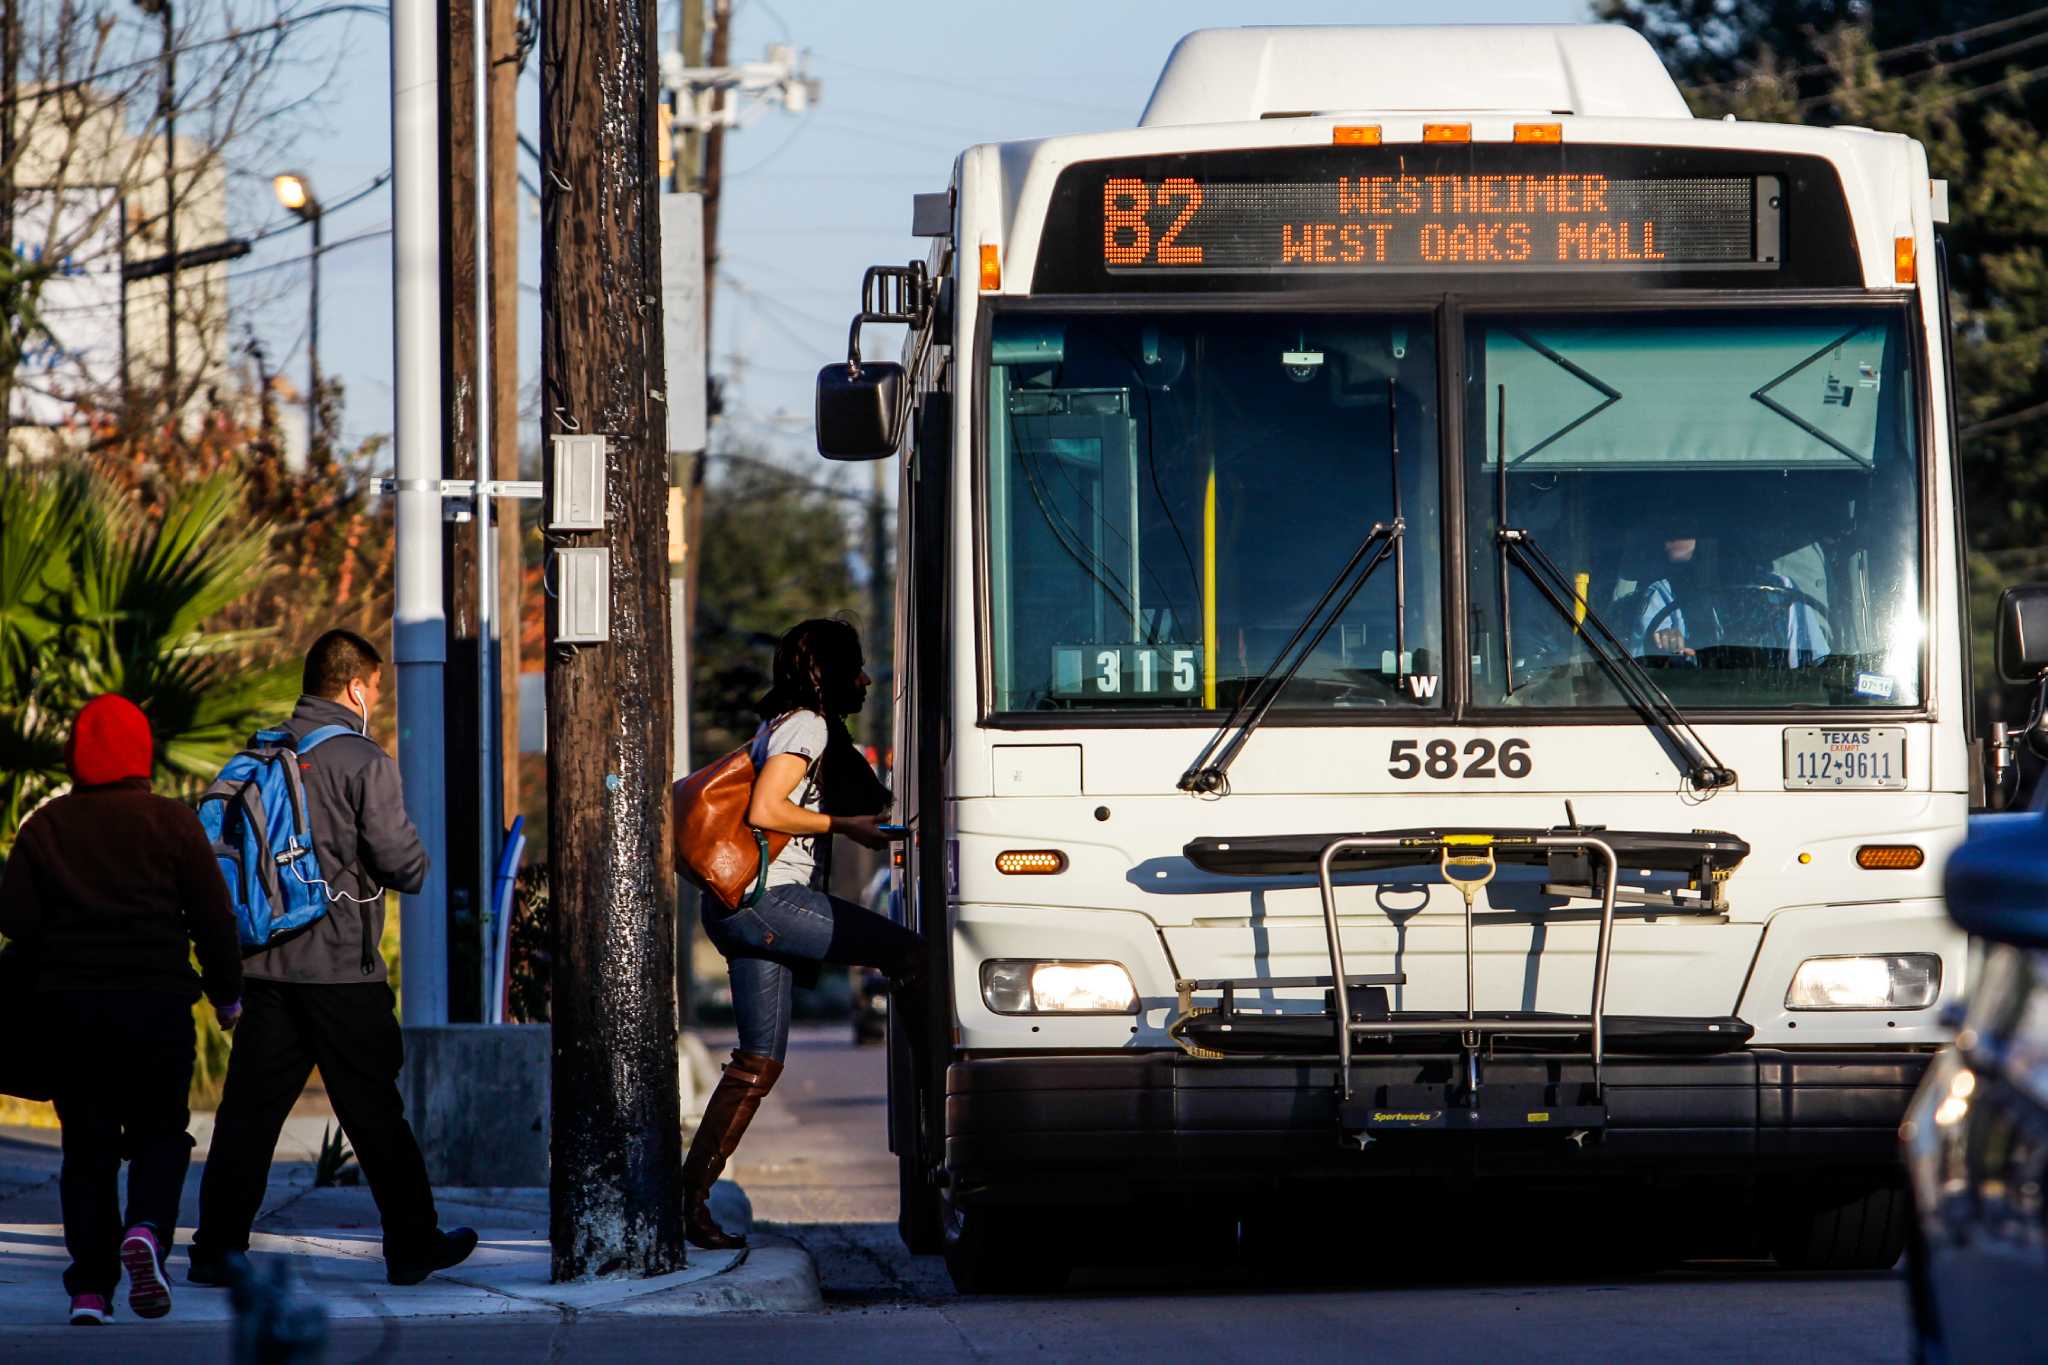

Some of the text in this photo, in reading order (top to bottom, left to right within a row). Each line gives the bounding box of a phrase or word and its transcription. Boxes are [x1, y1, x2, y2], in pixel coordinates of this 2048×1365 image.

[1339, 175, 1609, 214] WESTHEIMER
[1104, 178, 1203, 264] 82
[1283, 222, 1665, 262] WEST OAKS MALL
[1410, 675, 1438, 698] W
[1822, 733, 1870, 744] TEXAS
[1830, 744, 1861, 752] EXEMPT
[1387, 738, 1532, 780] 5826
[1373, 1111, 1431, 1122] Sportworks
